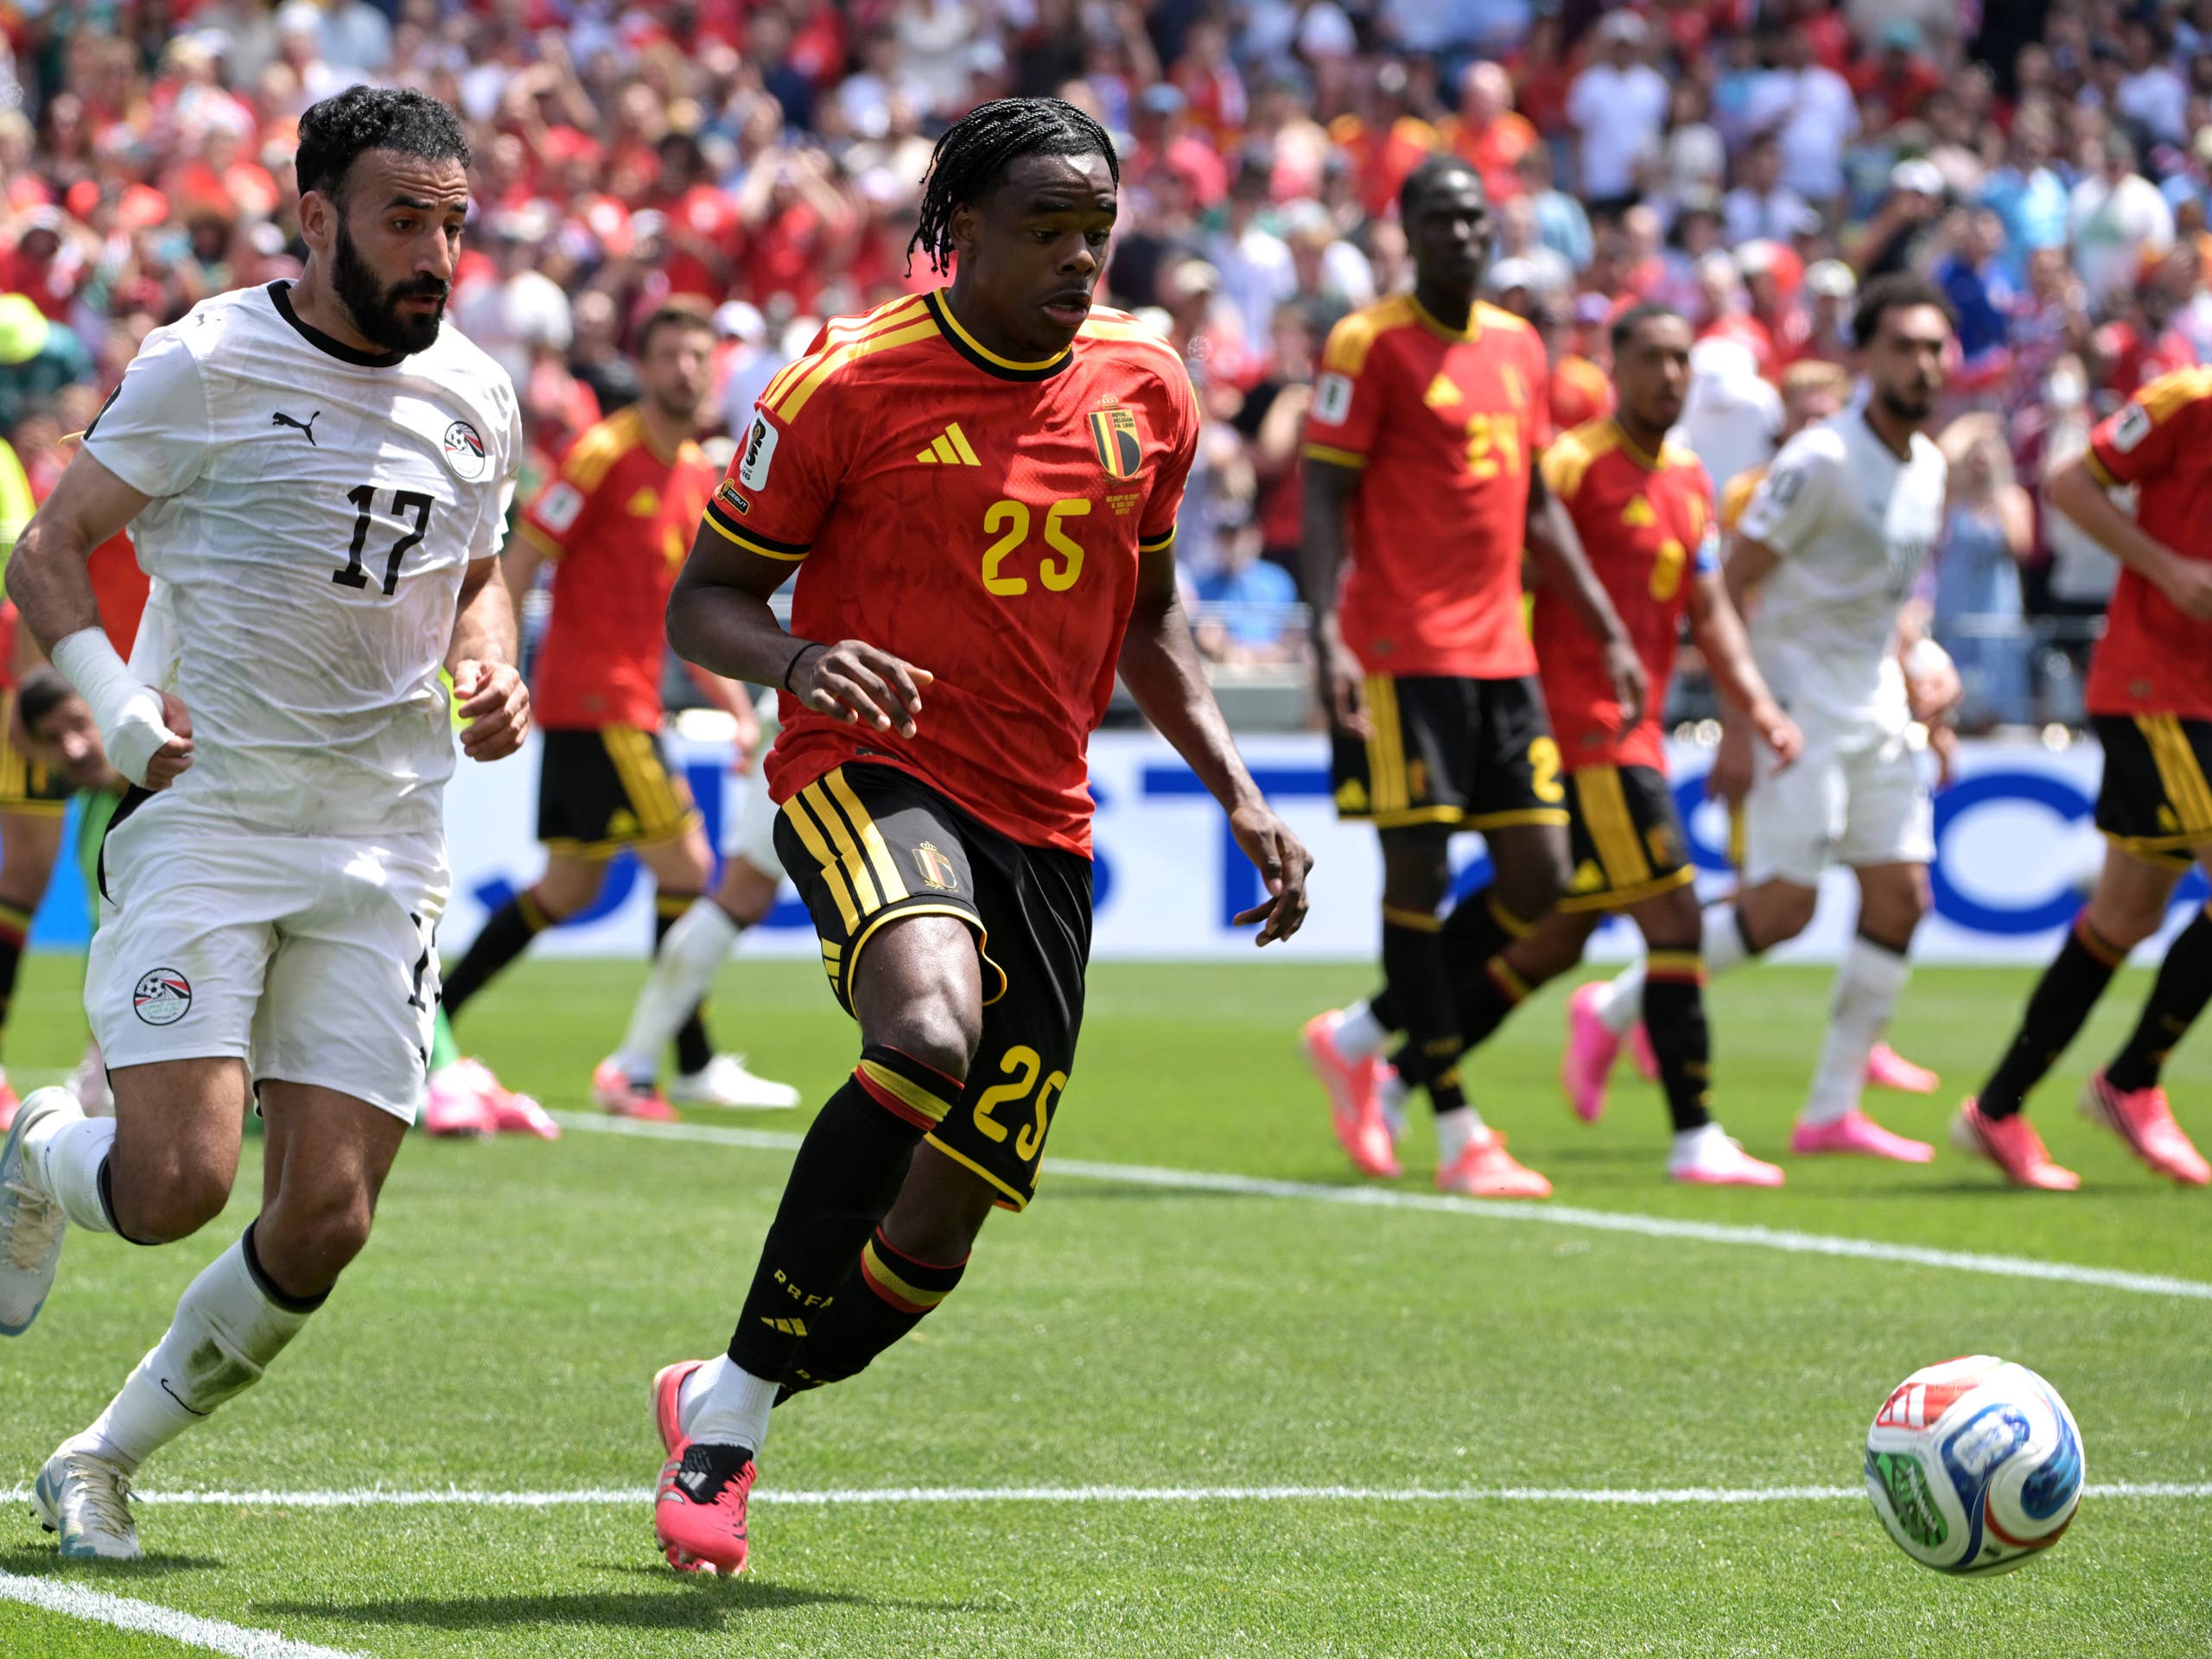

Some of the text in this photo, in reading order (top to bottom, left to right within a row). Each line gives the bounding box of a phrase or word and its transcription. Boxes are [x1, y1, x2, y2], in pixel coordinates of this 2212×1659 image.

[332, 485, 435, 595] 17
[728, 490, 747, 507] DEBUT
[982, 499, 1091, 596] 25
[973, 1045, 1069, 1162] 25
